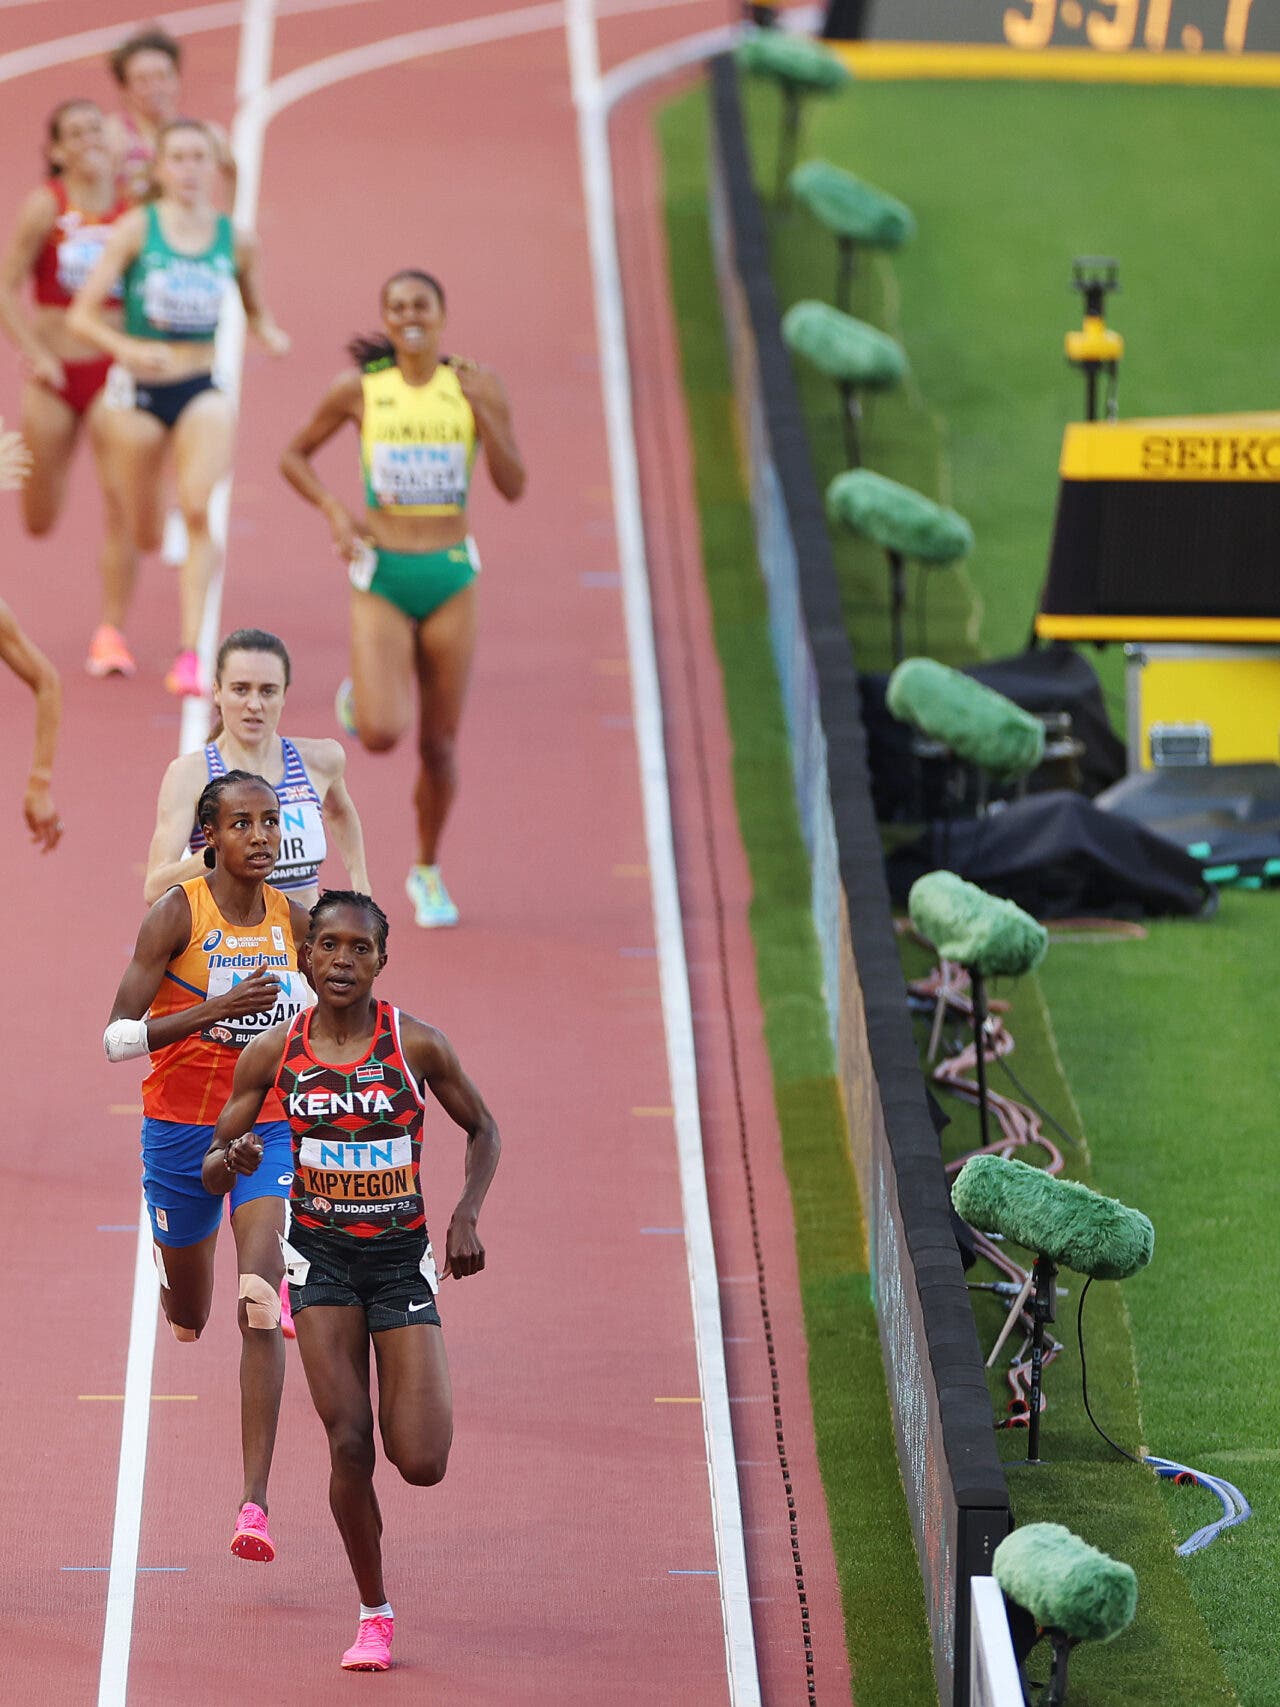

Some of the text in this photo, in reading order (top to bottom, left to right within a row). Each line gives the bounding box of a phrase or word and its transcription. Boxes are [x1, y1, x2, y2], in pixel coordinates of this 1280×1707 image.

[208, 952, 288, 969] Nederland
[289, 1090, 395, 1116] KENYA
[321, 1140, 392, 1168] NTN
[308, 1169, 408, 1198] KIPYEGON
[334, 1203, 396, 1214] BUDAPEST
[397, 1200, 411, 1210] 23
